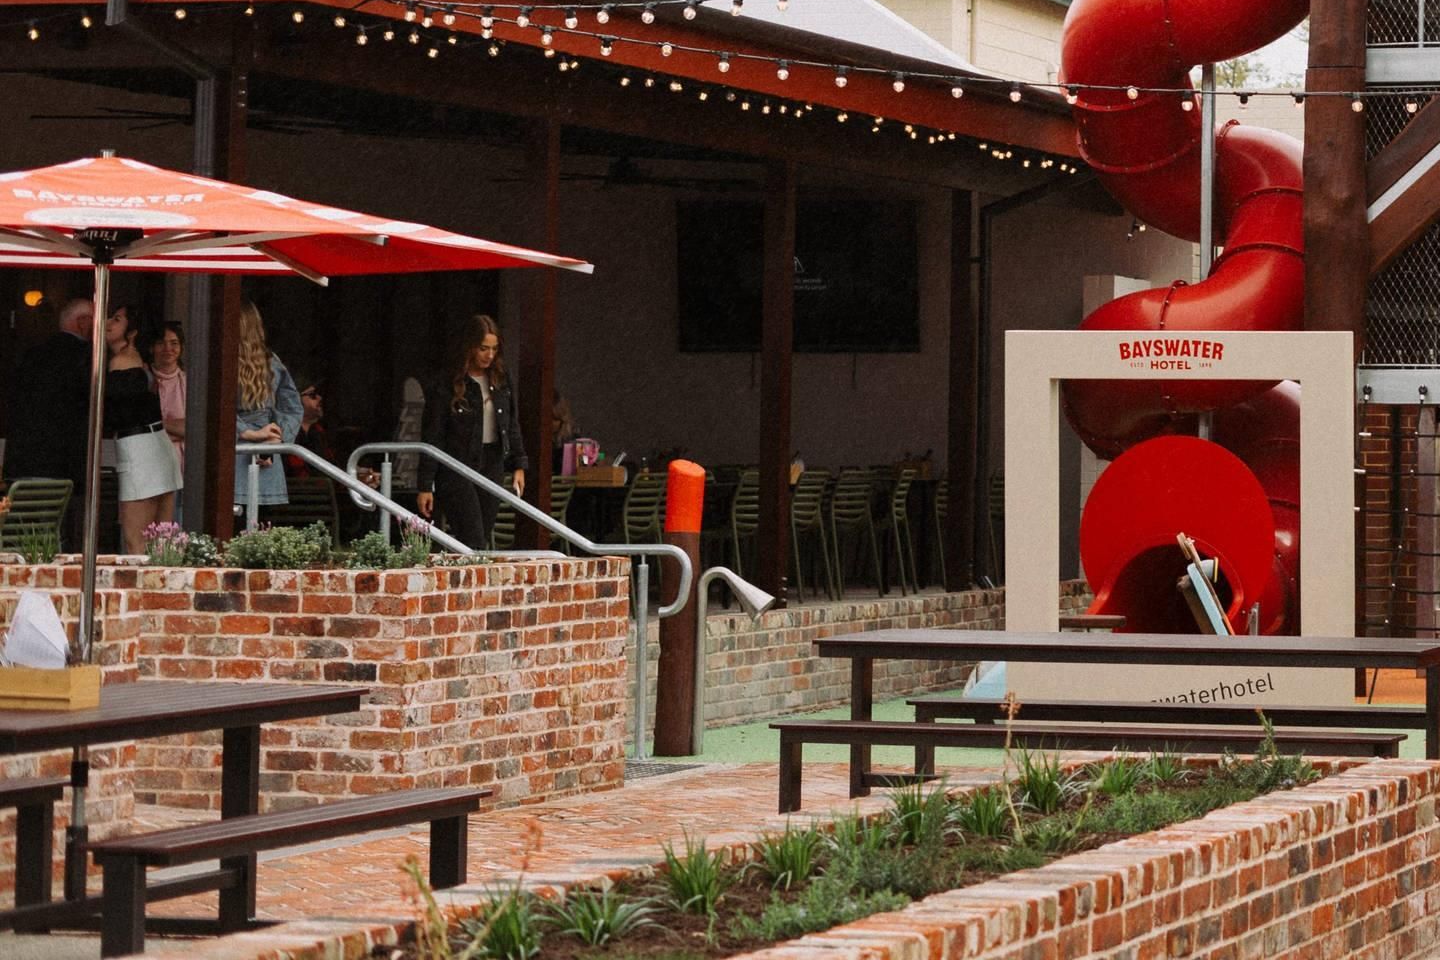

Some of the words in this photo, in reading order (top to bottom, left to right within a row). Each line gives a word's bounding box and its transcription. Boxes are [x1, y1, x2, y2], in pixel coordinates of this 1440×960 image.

[1119, 339, 1224, 361] BAYSWATER
[1150, 360, 1192, 370] HOTEL
[1151, 672, 1275, 704] aterhotel
